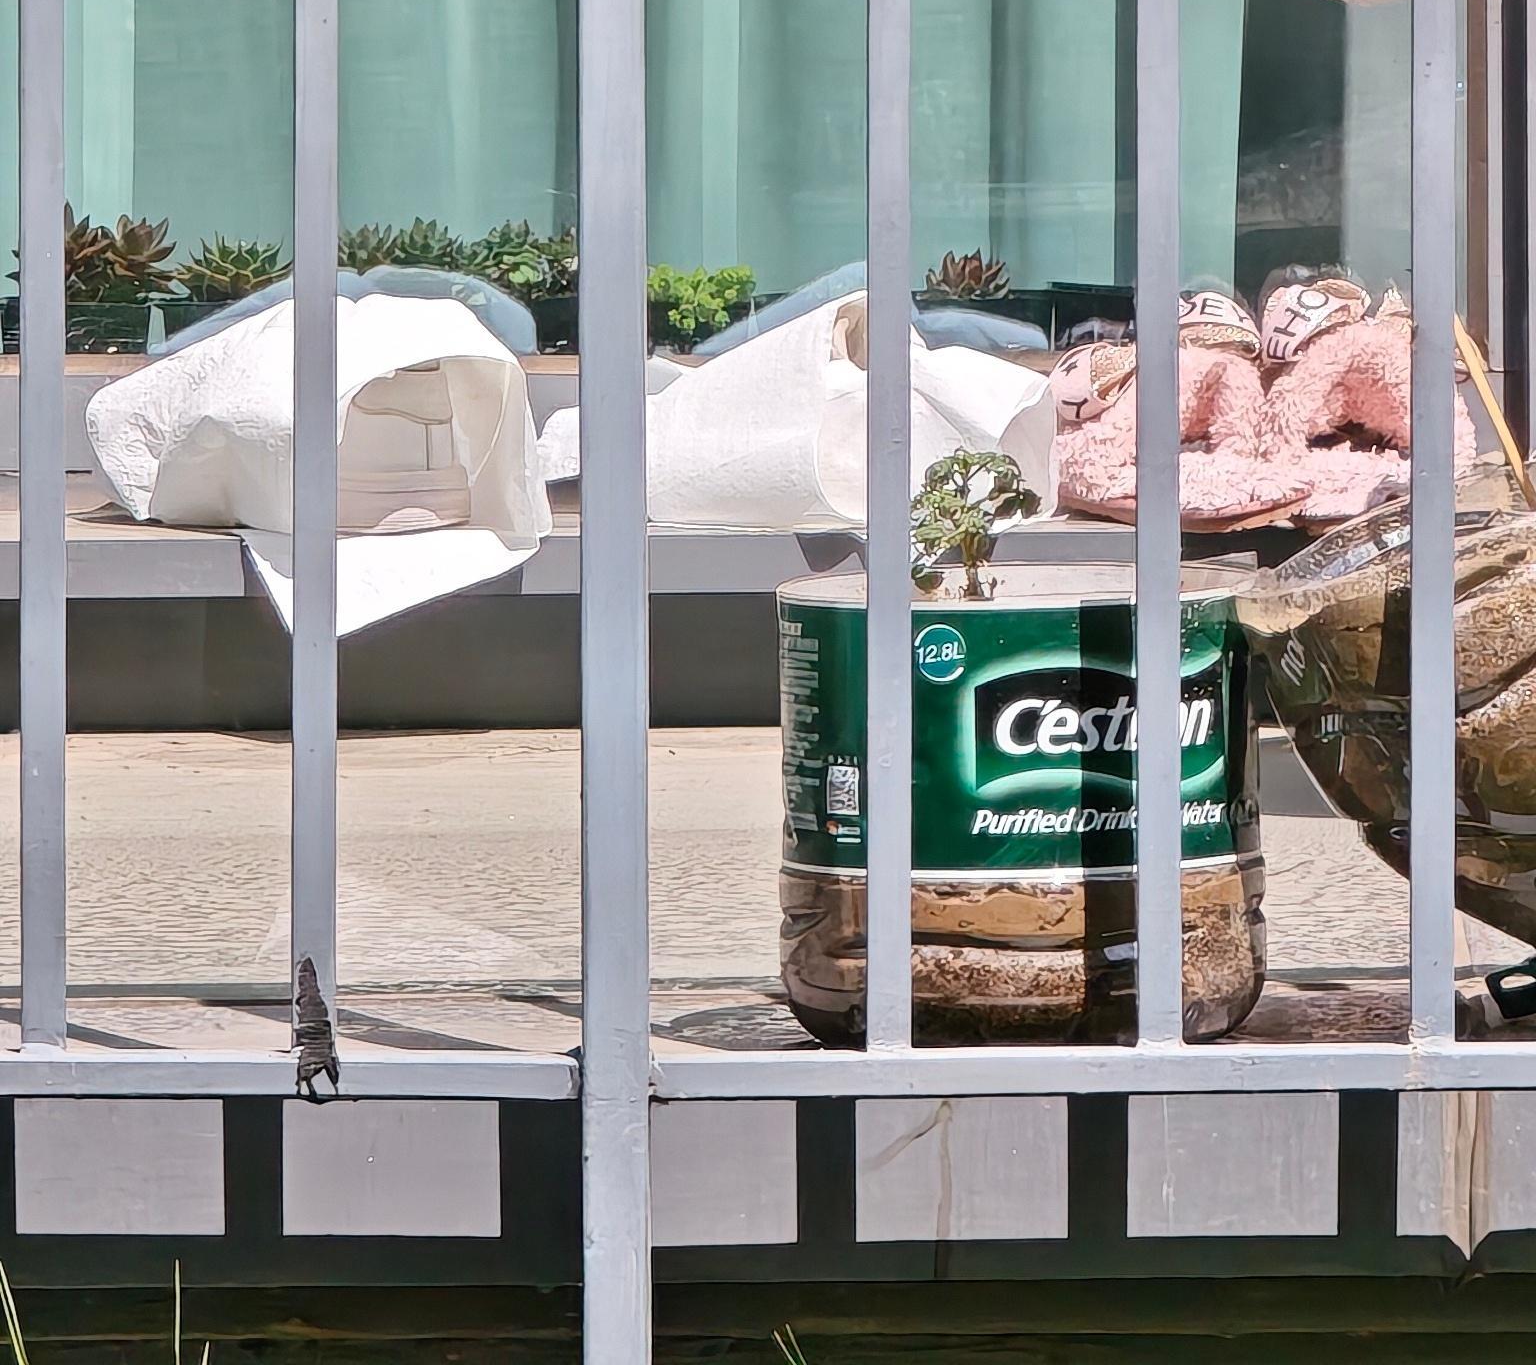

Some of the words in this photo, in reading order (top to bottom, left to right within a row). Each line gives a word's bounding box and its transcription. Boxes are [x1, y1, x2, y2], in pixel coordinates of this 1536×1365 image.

[916, 641, 966, 664] 12.8L
[994, 695, 1212, 756] C'estn
[971, 807, 1077, 835] Purified
